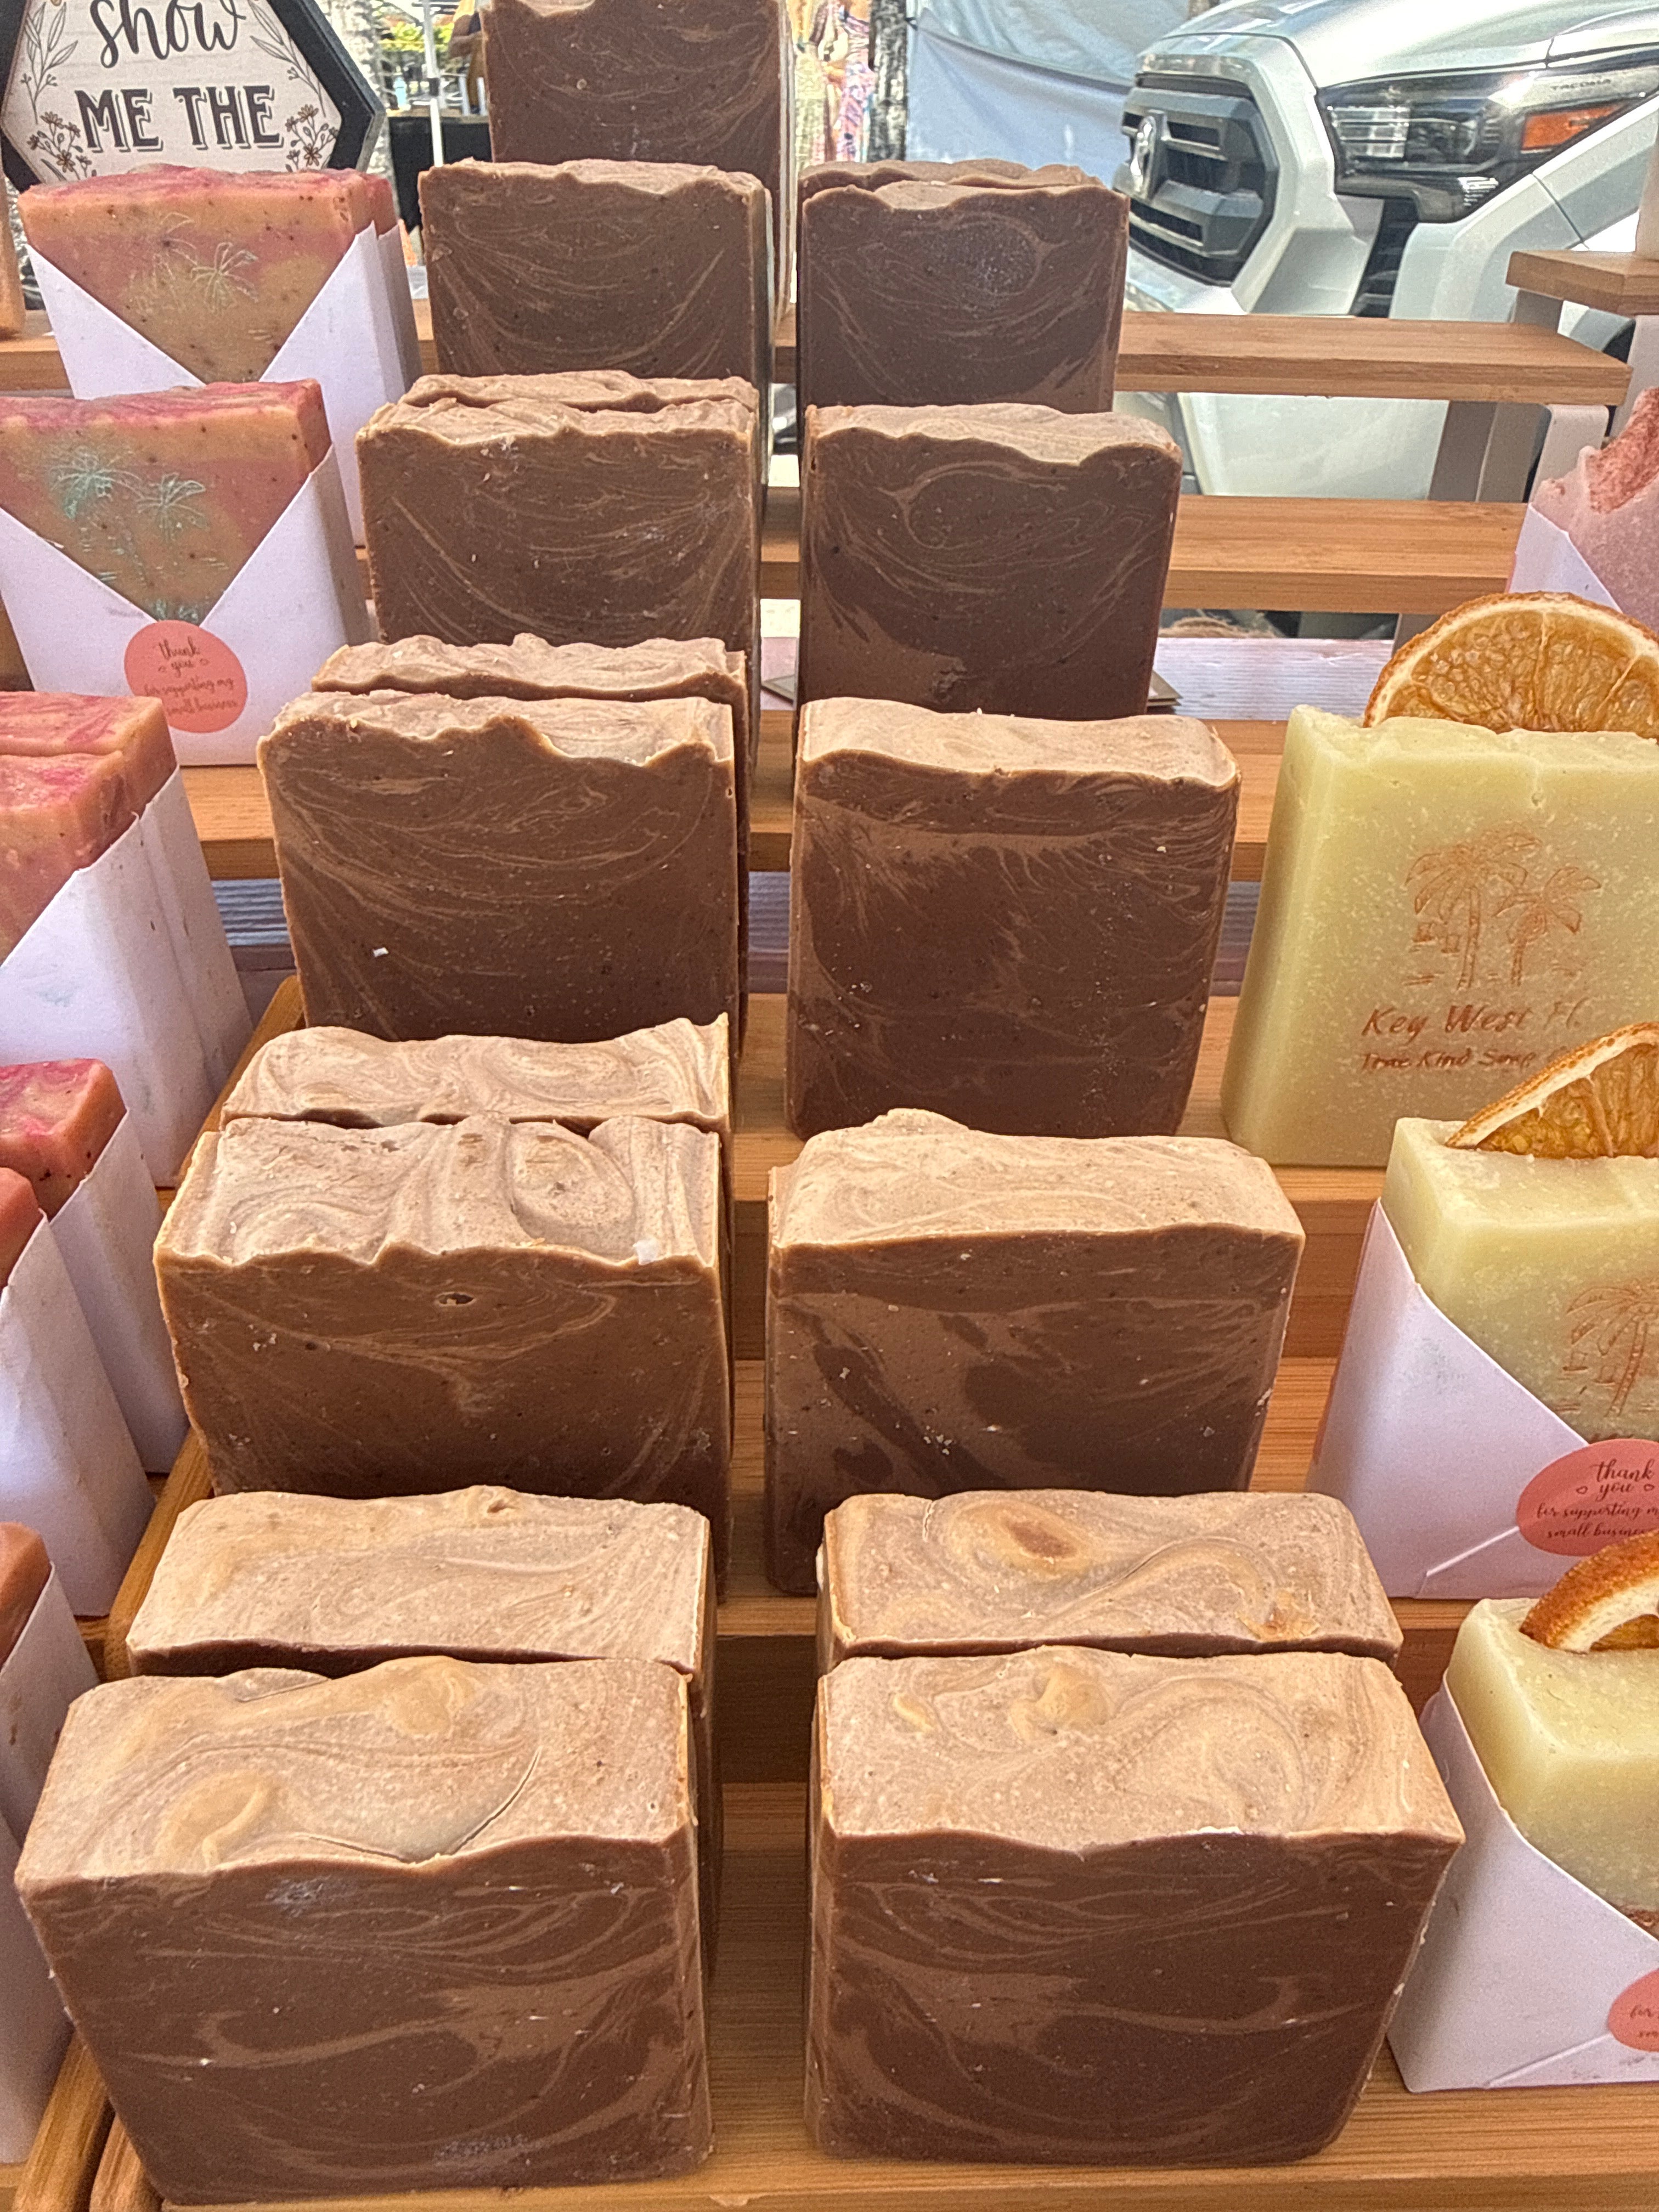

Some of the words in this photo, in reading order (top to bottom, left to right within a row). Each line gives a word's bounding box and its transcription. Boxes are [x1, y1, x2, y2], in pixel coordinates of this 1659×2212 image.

[89, 0, 246, 69] show
[1550, 78, 1611, 91] TACOMA
[75, 89, 163, 153] ME
[173, 85, 284, 150] THE
[1361, 1006, 1427, 1044] Key
[1444, 1004, 1532, 1032] West
[1590, 1458, 1655, 1482] thank
[1595, 1483, 1634, 1502] you
[1537, 1502, 1558, 1519] for
[1562, 1501, 1640, 1520] supporting
[1547, 1522, 1592, 1539] small
